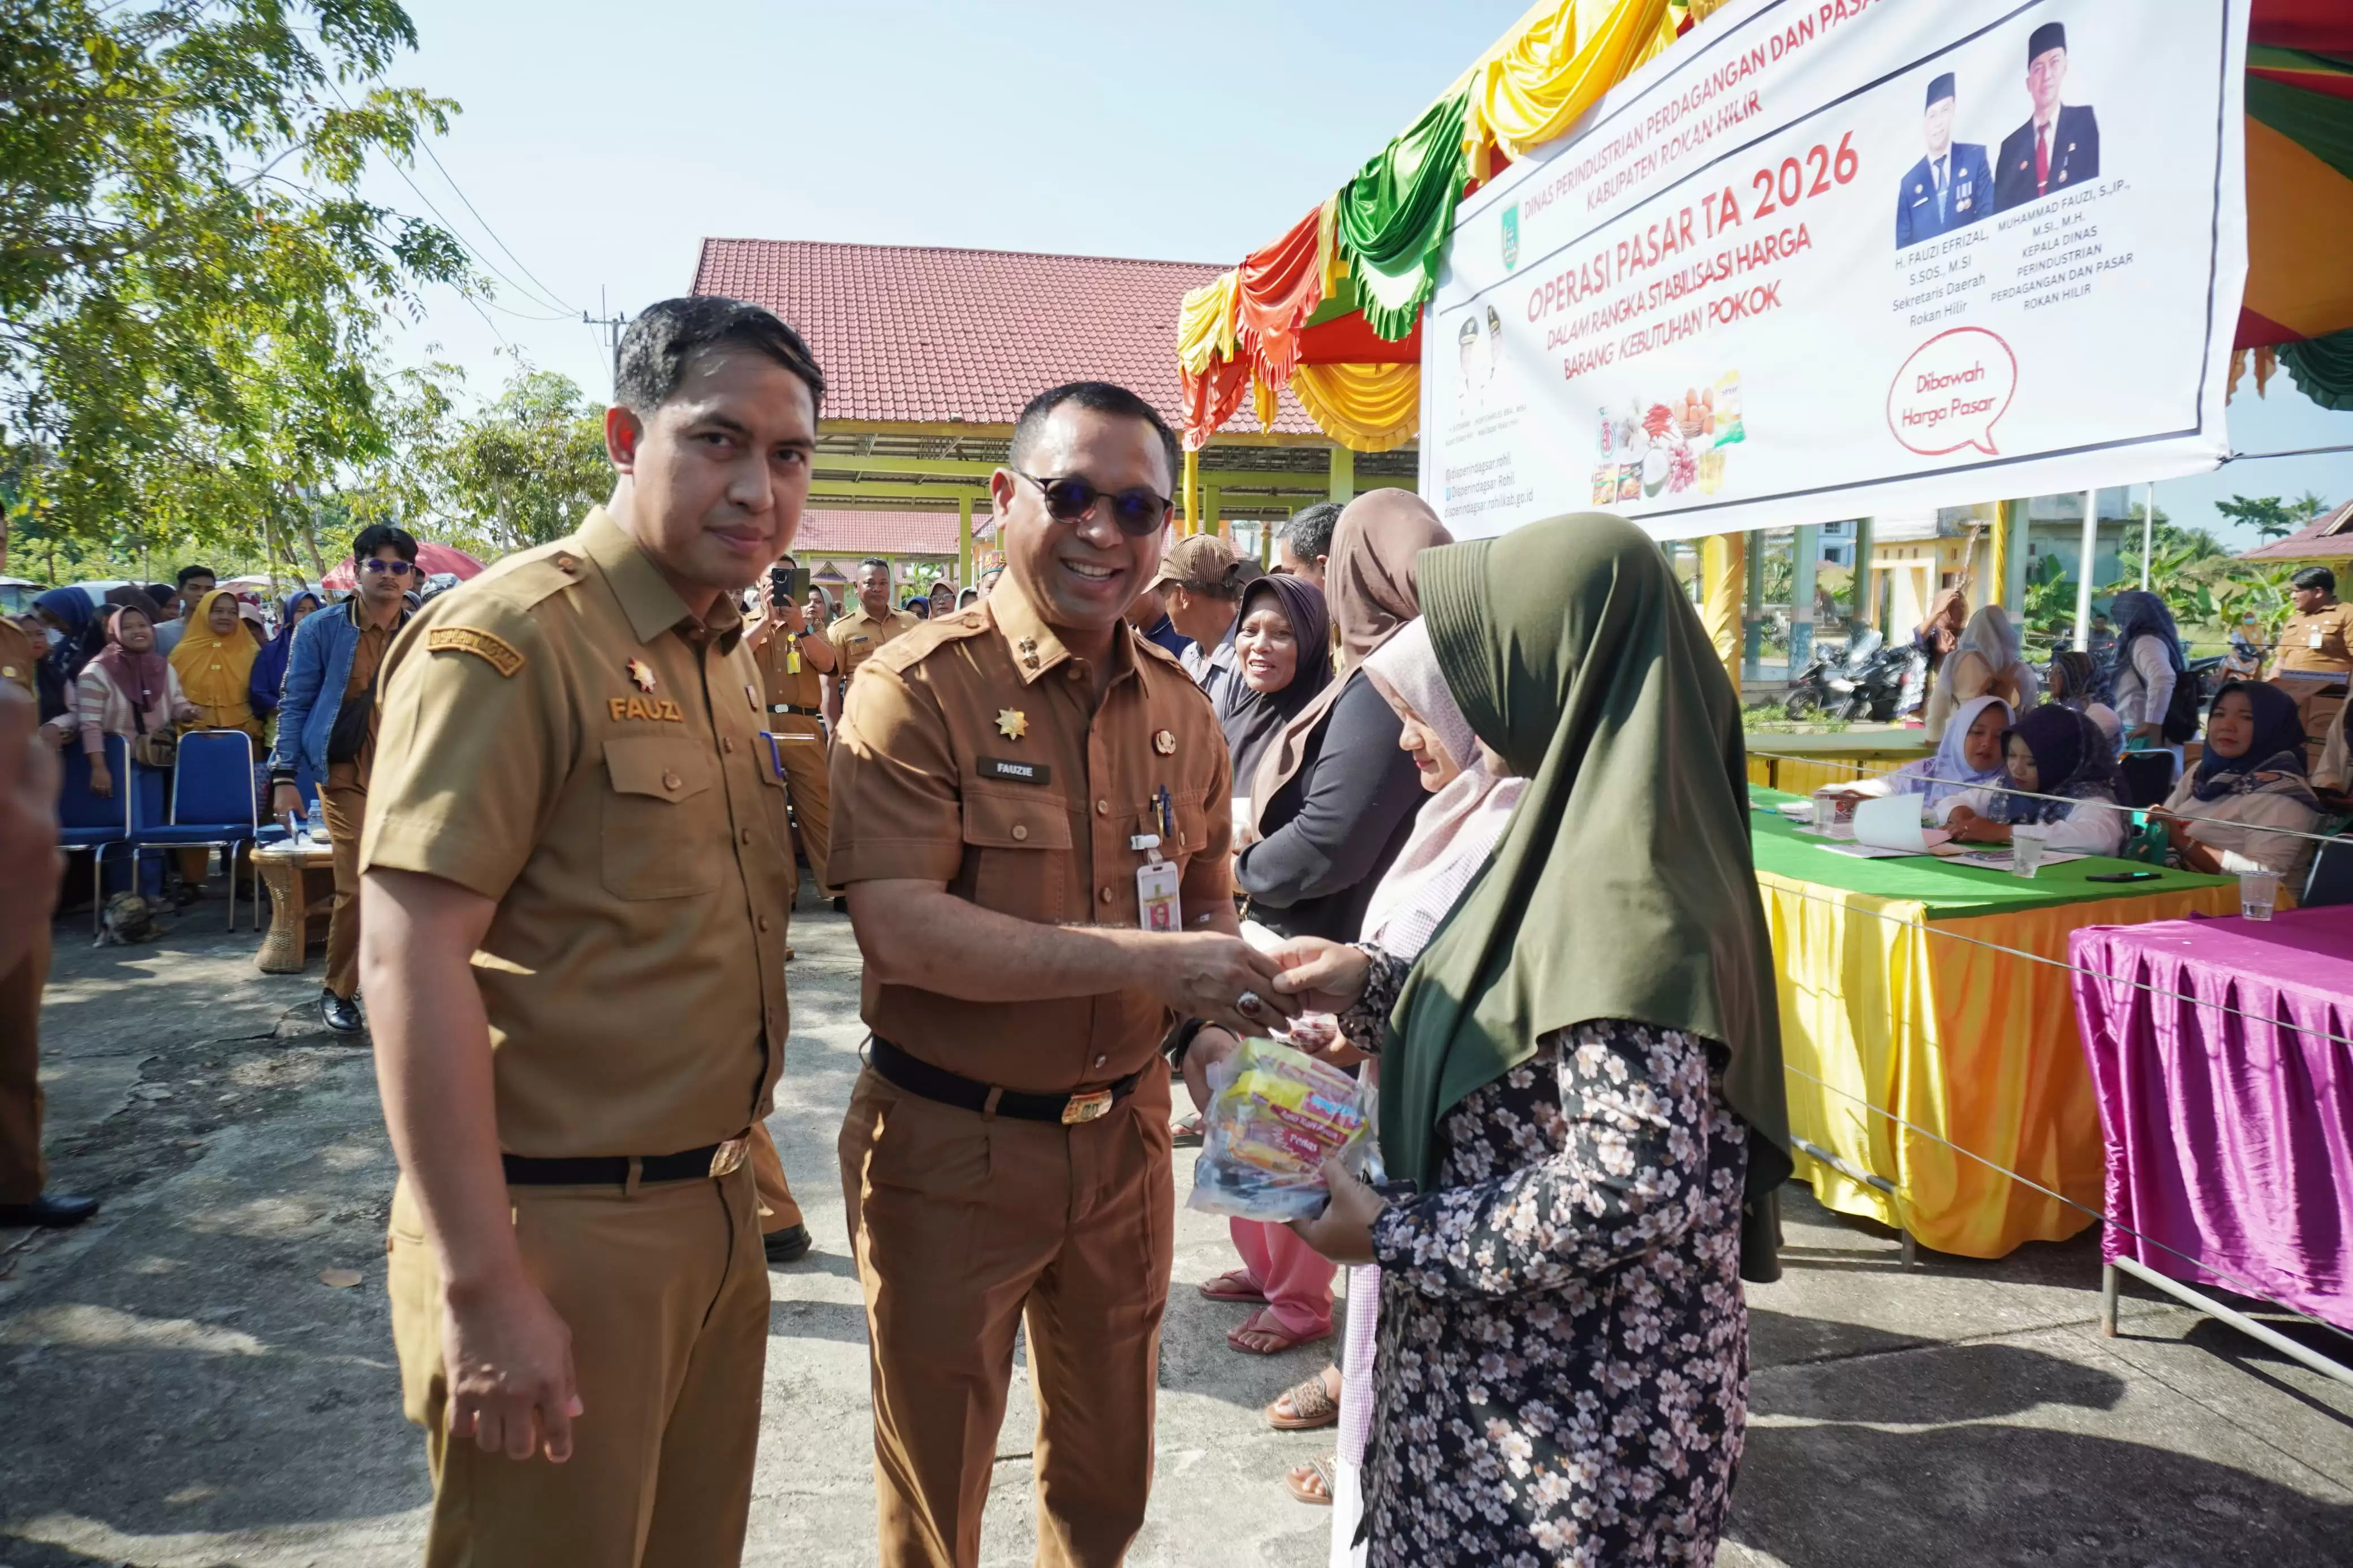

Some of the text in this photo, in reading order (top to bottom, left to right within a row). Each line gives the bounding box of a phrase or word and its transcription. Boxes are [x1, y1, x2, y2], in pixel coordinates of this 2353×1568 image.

[1525, 185, 1554, 219] DINAS
[1556, 125, 1643, 199] PERINDUSTRIAN
[1647, 44, 1765, 140] PERDAGANGAN
[1770, 13, 1814, 62] DAN
[1587, 89, 1763, 213] KABUPATEN ROKAN HILIR
[1527, 130, 1859, 323] OPERASI PASAR TA 2026
[1998, 202, 2059, 232] MUHAMMAD
[2061, 191, 2096, 210] FAUZI,
[2062, 211, 2086, 228] M.H.
[1895, 228, 1989, 270] H. FAUZI EFRIZAL,
[2022, 226, 2098, 258] KEPALA DINAS
[1949, 254, 1972, 273] M.SI
[1991, 253, 2134, 303] PERDAGANGAN DAN PASAR
[2017, 244, 2102, 278] PERINDUSTRIAN
[1548, 222, 1813, 351] DALAM RANGKA STABILISASI HARGA
[1893, 273, 1986, 312] Sekretaris Daerah
[2024, 283, 2091, 311] ROKAN HILIR
[1564, 279, 1783, 381] BARANG KEBUTUHAN POKOK
[1910, 300, 1968, 327] Rokan Hilir
[1916, 360, 1985, 395] Dibawah
[1902, 395, 1997, 428] Harga Pasar
[1452, 470, 1515, 498] Disperindagsar Rohil
[997, 762, 1033, 777] FAUZIE
